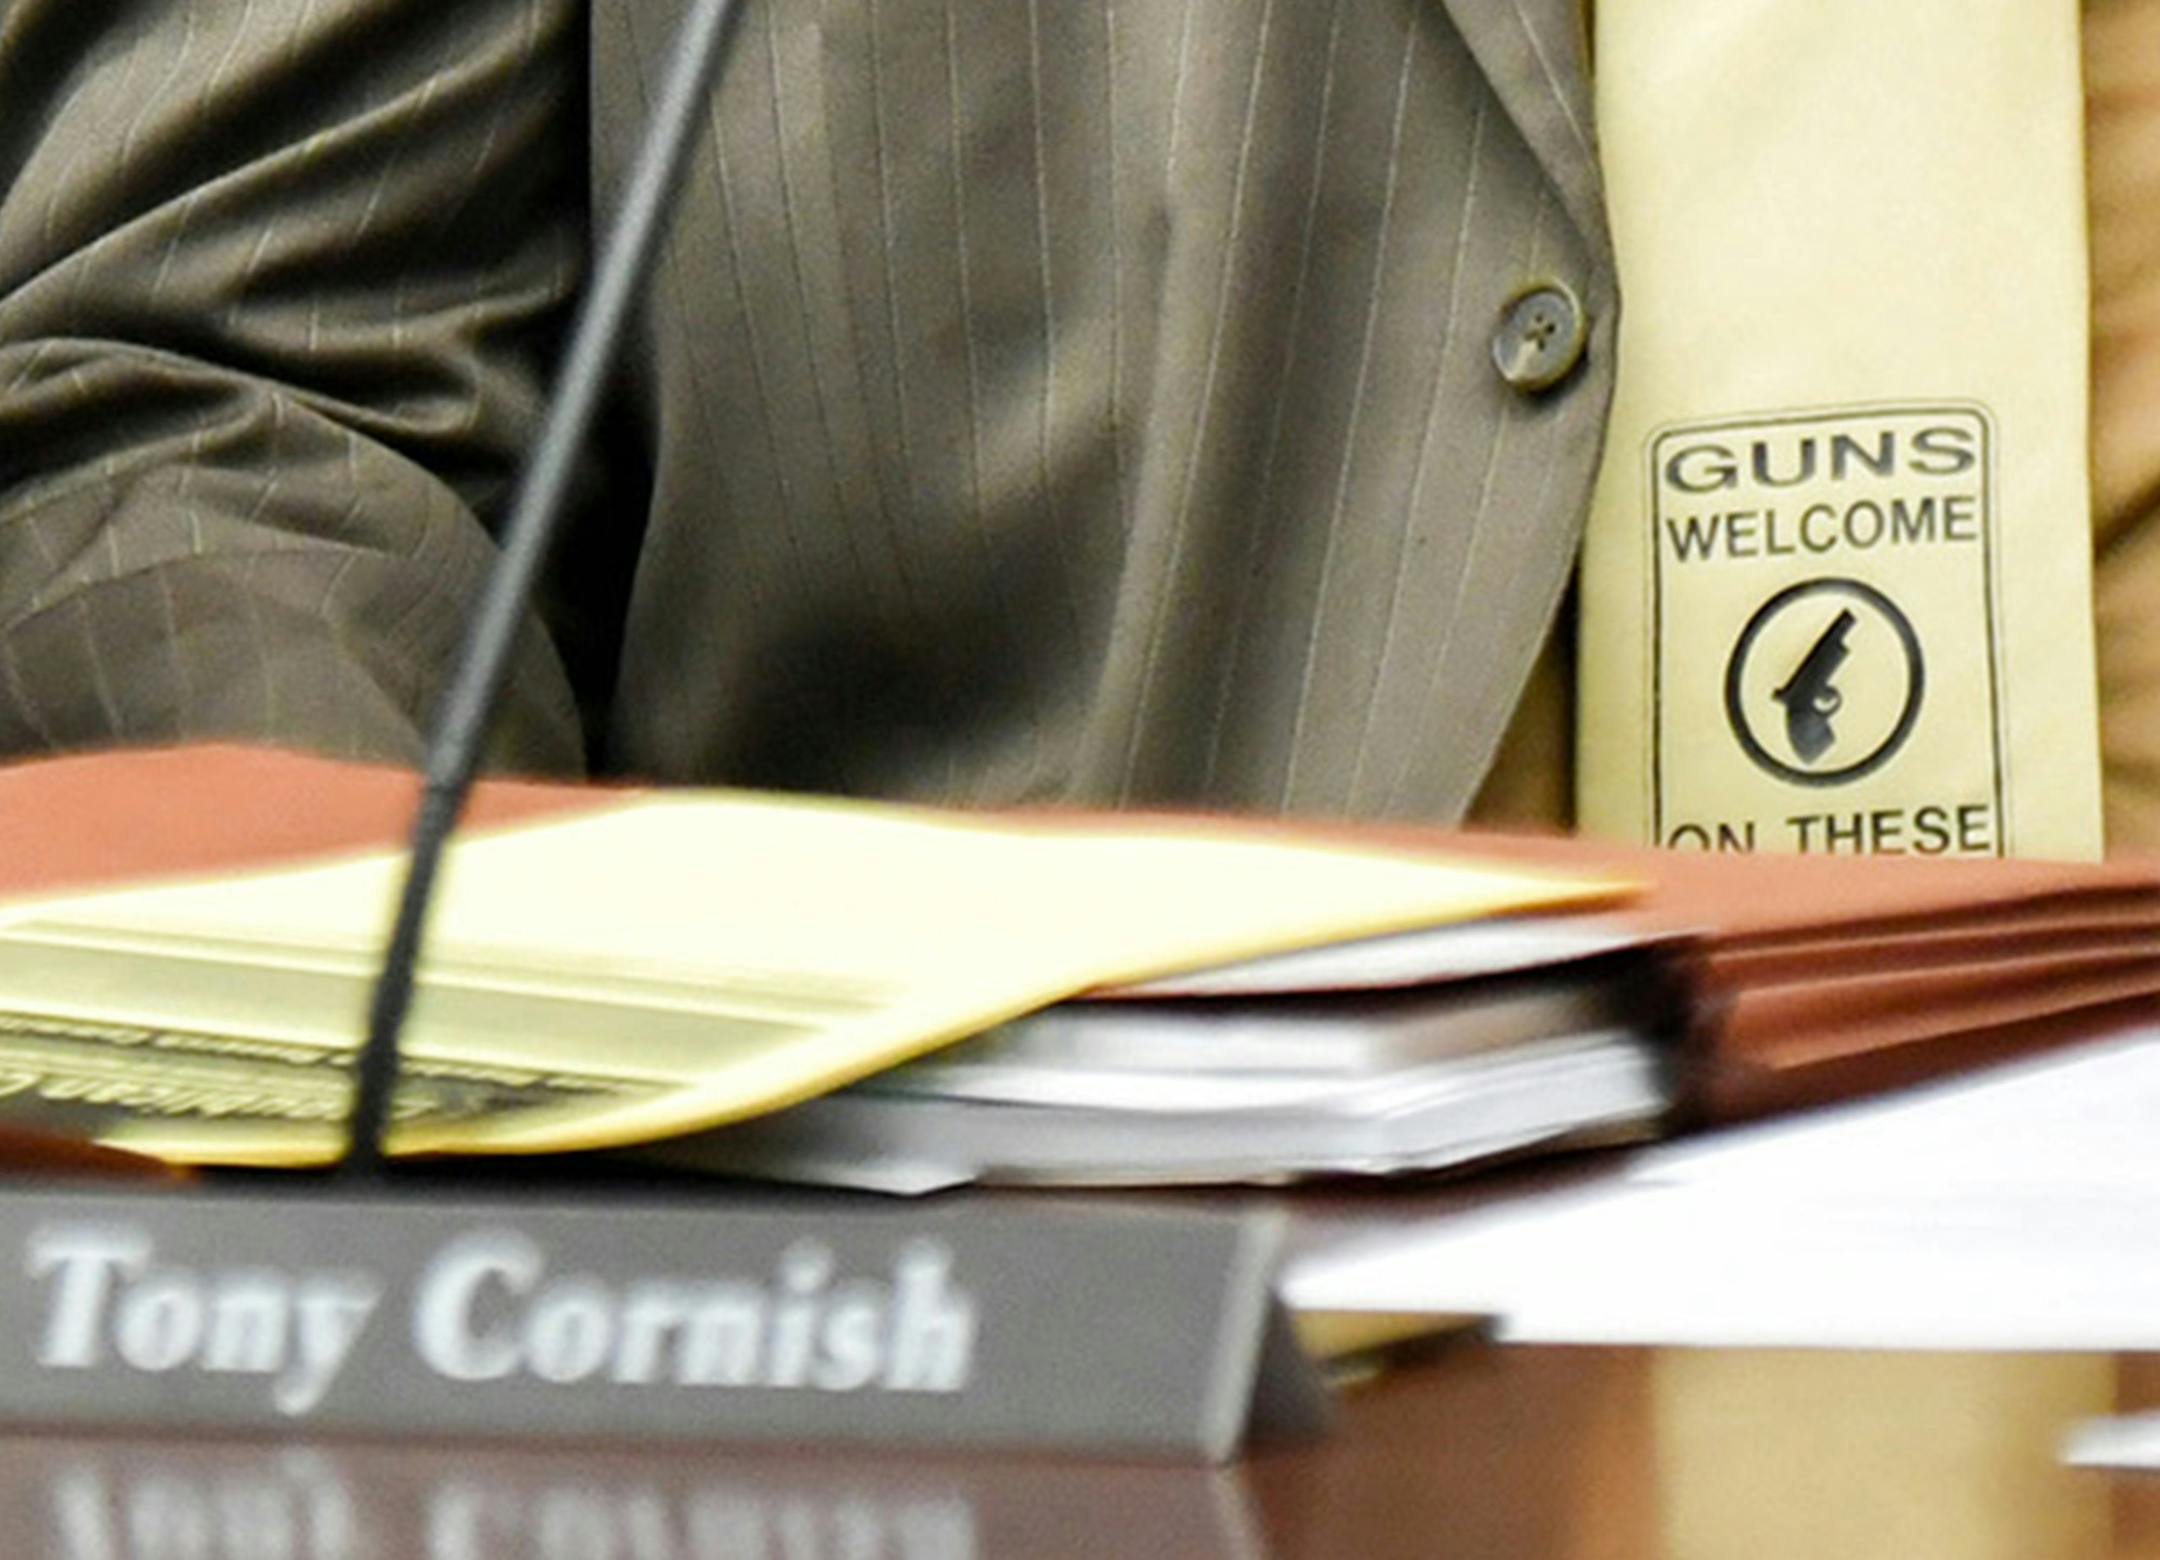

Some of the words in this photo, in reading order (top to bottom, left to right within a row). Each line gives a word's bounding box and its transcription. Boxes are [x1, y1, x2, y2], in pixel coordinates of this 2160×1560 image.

[1665, 428, 1976, 493] GUNS
[1666, 496, 1977, 562] WELCOME
[1669, 823, 1754, 852] ON
[1787, 804, 1990, 854] THESE
[27, 1219, 381, 1414] Tony
[414, 1226, 977, 1391] Cornish
